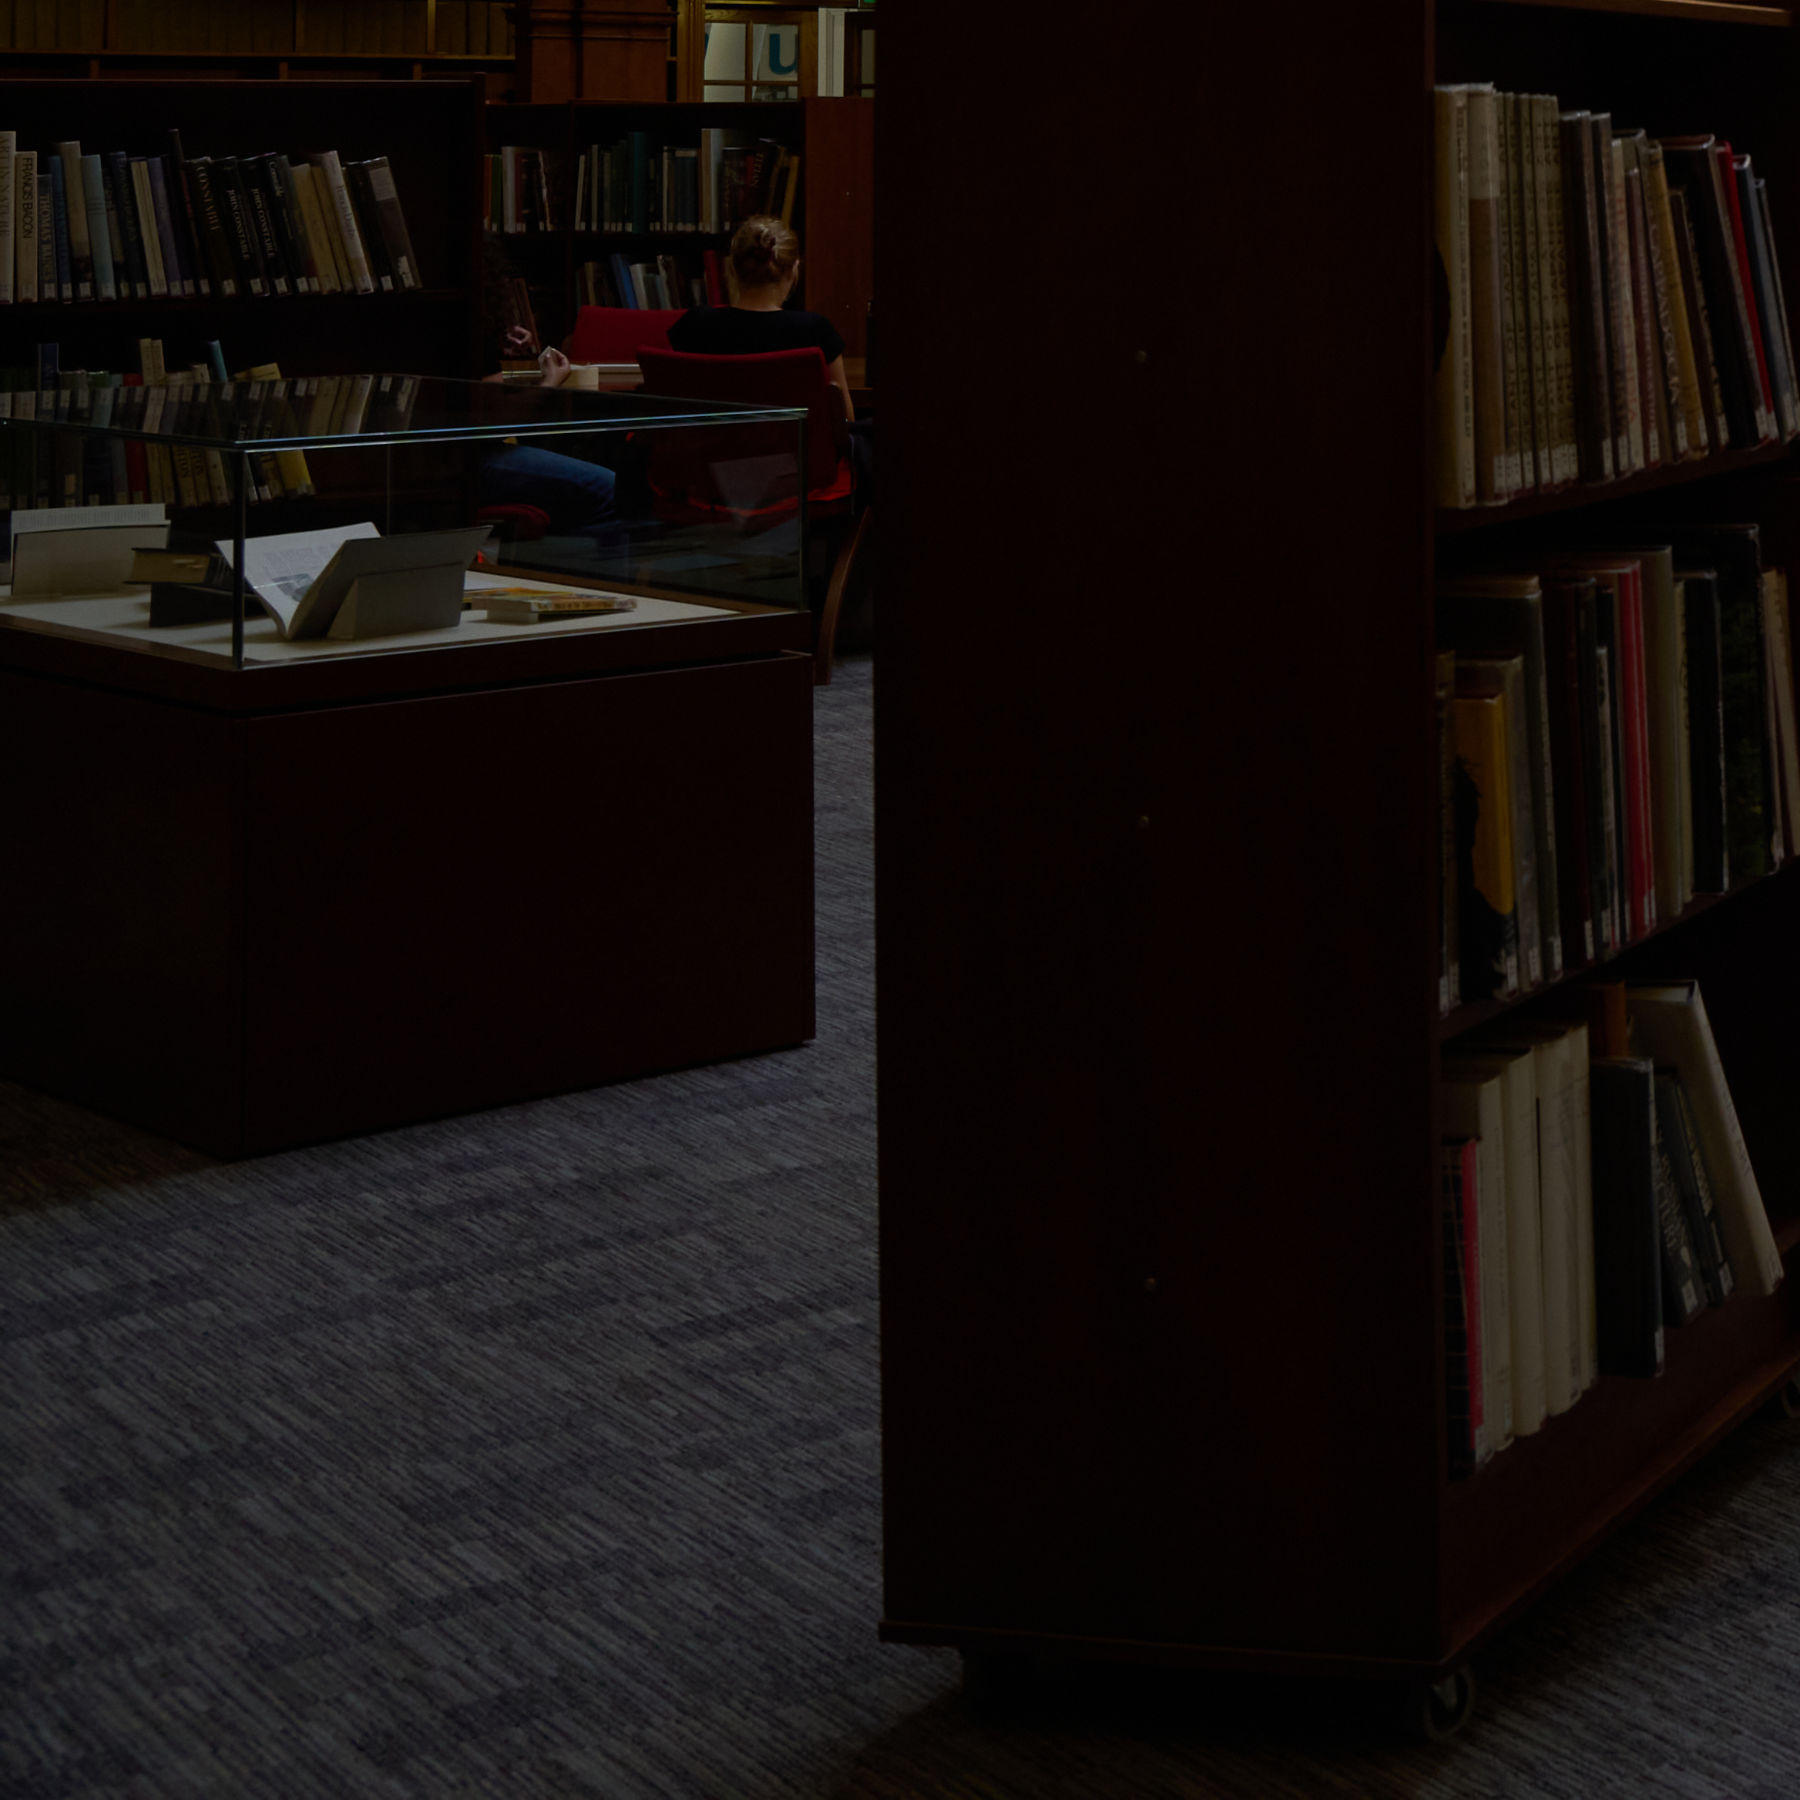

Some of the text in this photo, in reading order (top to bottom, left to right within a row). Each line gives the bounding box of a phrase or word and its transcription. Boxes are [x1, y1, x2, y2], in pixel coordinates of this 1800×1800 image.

[22, 157, 33, 239] FRANCIS BACON
[40, 193, 51, 241] THOMAS
[196, 164, 222, 232] CONSTABLE
[225, 188, 249, 260] JOHN CONSTABLE
[251, 188, 275, 258] JOHN CONSTABLE
[1650, 224, 1681, 404] CAPPADOCIA
